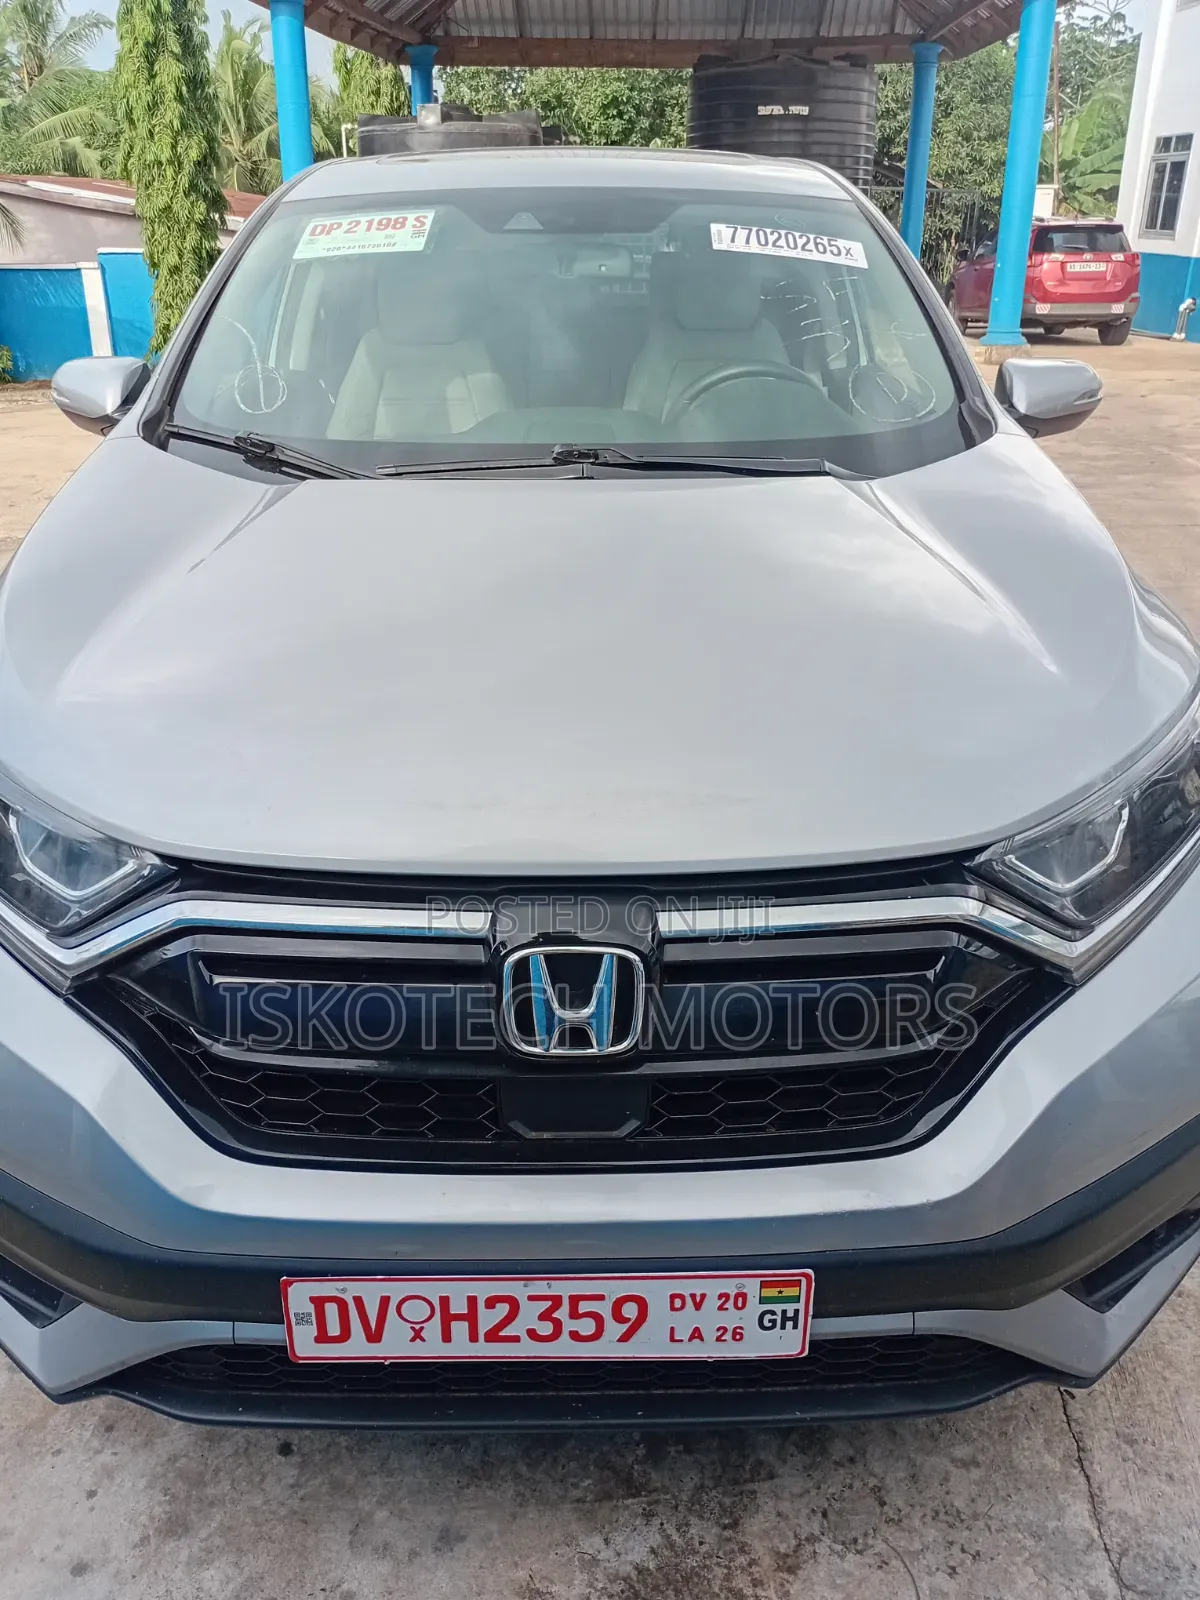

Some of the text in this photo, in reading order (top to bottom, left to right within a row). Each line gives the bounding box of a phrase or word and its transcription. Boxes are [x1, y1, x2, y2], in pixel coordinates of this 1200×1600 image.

[669, 1291, 748, 1312] DV 20
[309, 1295, 391, 1344] DV
[439, 1294, 649, 1344] H2359
[757, 1308, 800, 1332] GH
[669, 1325, 745, 1343] LA 26
